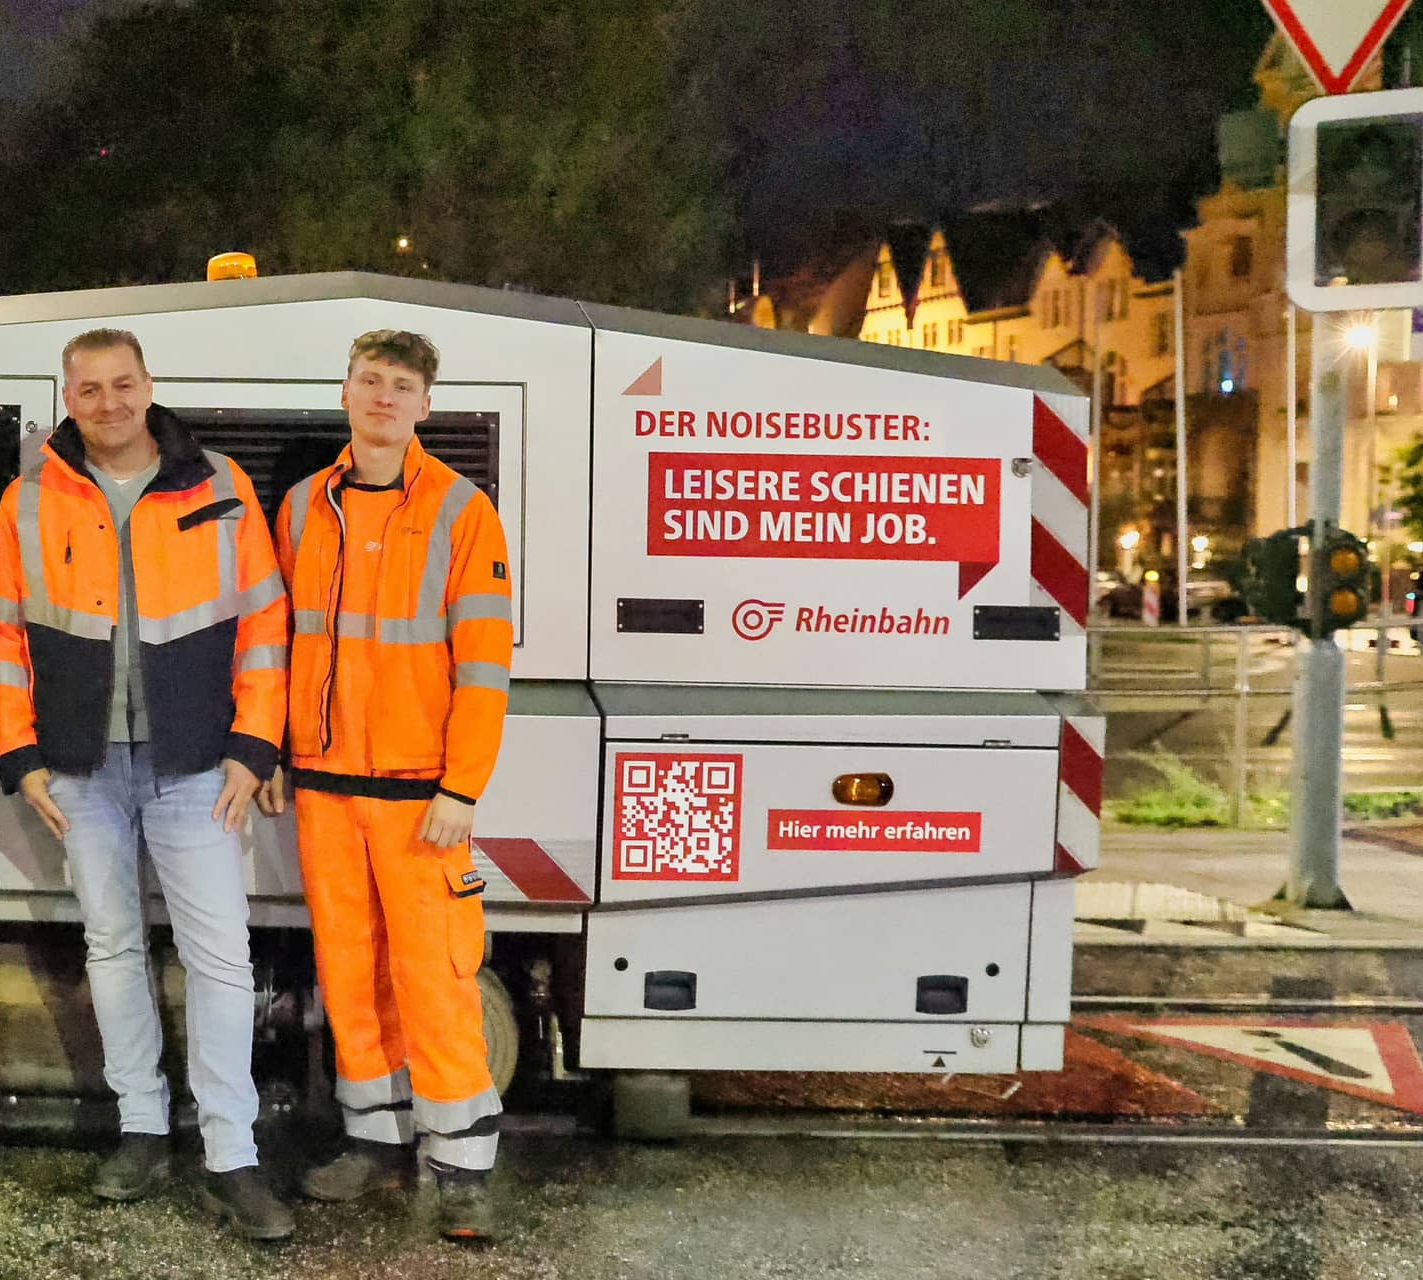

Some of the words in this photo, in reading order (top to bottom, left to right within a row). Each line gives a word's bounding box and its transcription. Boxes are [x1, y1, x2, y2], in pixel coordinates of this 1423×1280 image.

[635, 410, 696, 437] DER
[706, 411, 930, 441] NOISEBUSTER:
[665, 469, 800, 501] LEISERE
[810, 471, 985, 505] SCHIENEN
[664, 509, 749, 541] SIND
[760, 512, 851, 543] MEIN
[861, 514, 936, 545] JOB.
[795, 606, 950, 635] Rheinbahn
[779, 821, 820, 839] Hier
[825, 821, 879, 839] mehr
[884, 822, 970, 840] erfahren
